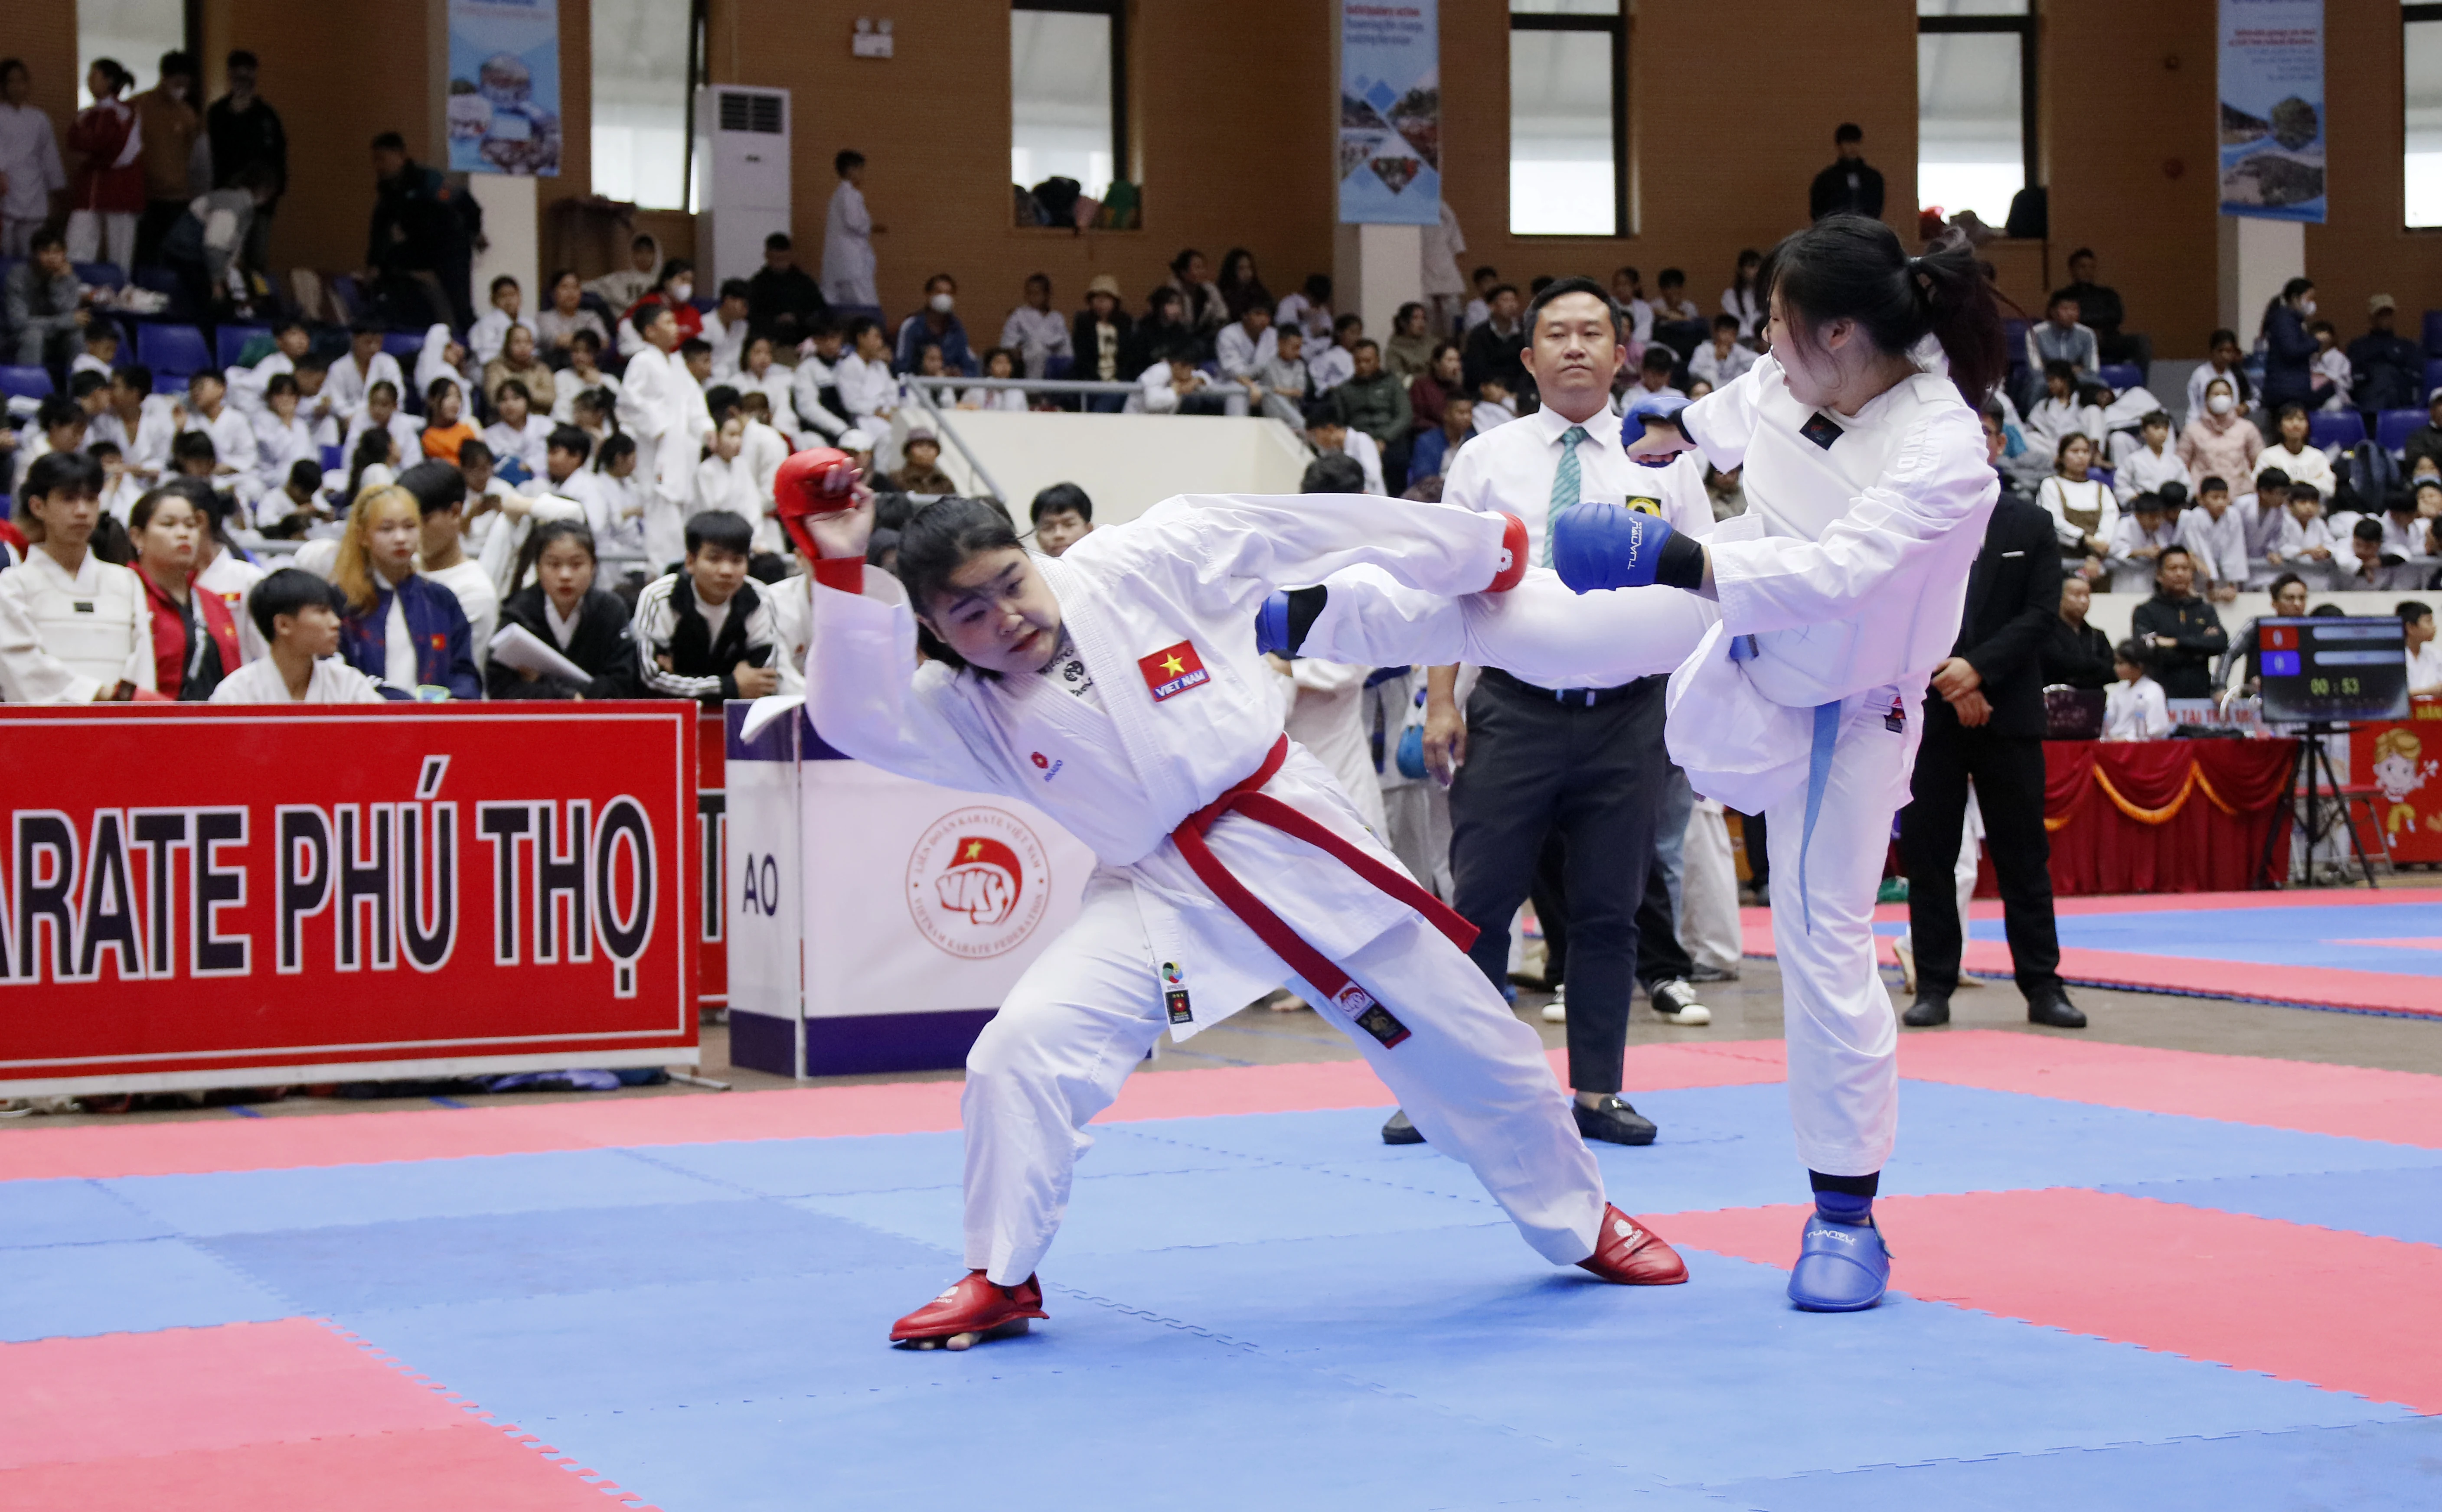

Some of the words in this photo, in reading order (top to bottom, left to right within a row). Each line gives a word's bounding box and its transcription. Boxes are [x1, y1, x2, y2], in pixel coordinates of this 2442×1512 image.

[1155, 680, 1180, 696] VIET
[1181, 671, 1205, 686] NAM
[958, 814, 1004, 826] KARATE
[1026, 844, 1041, 869] NAM
[0, 805, 252, 986] RATE
[275, 754, 457, 974] PHÚ
[476, 794, 658, 999] THỌ
[743, 852, 778, 917] AO
[914, 897, 946, 942] VIETNAM
[947, 939, 991, 954] KARATE
[994, 893, 1043, 952] FEDERATION
